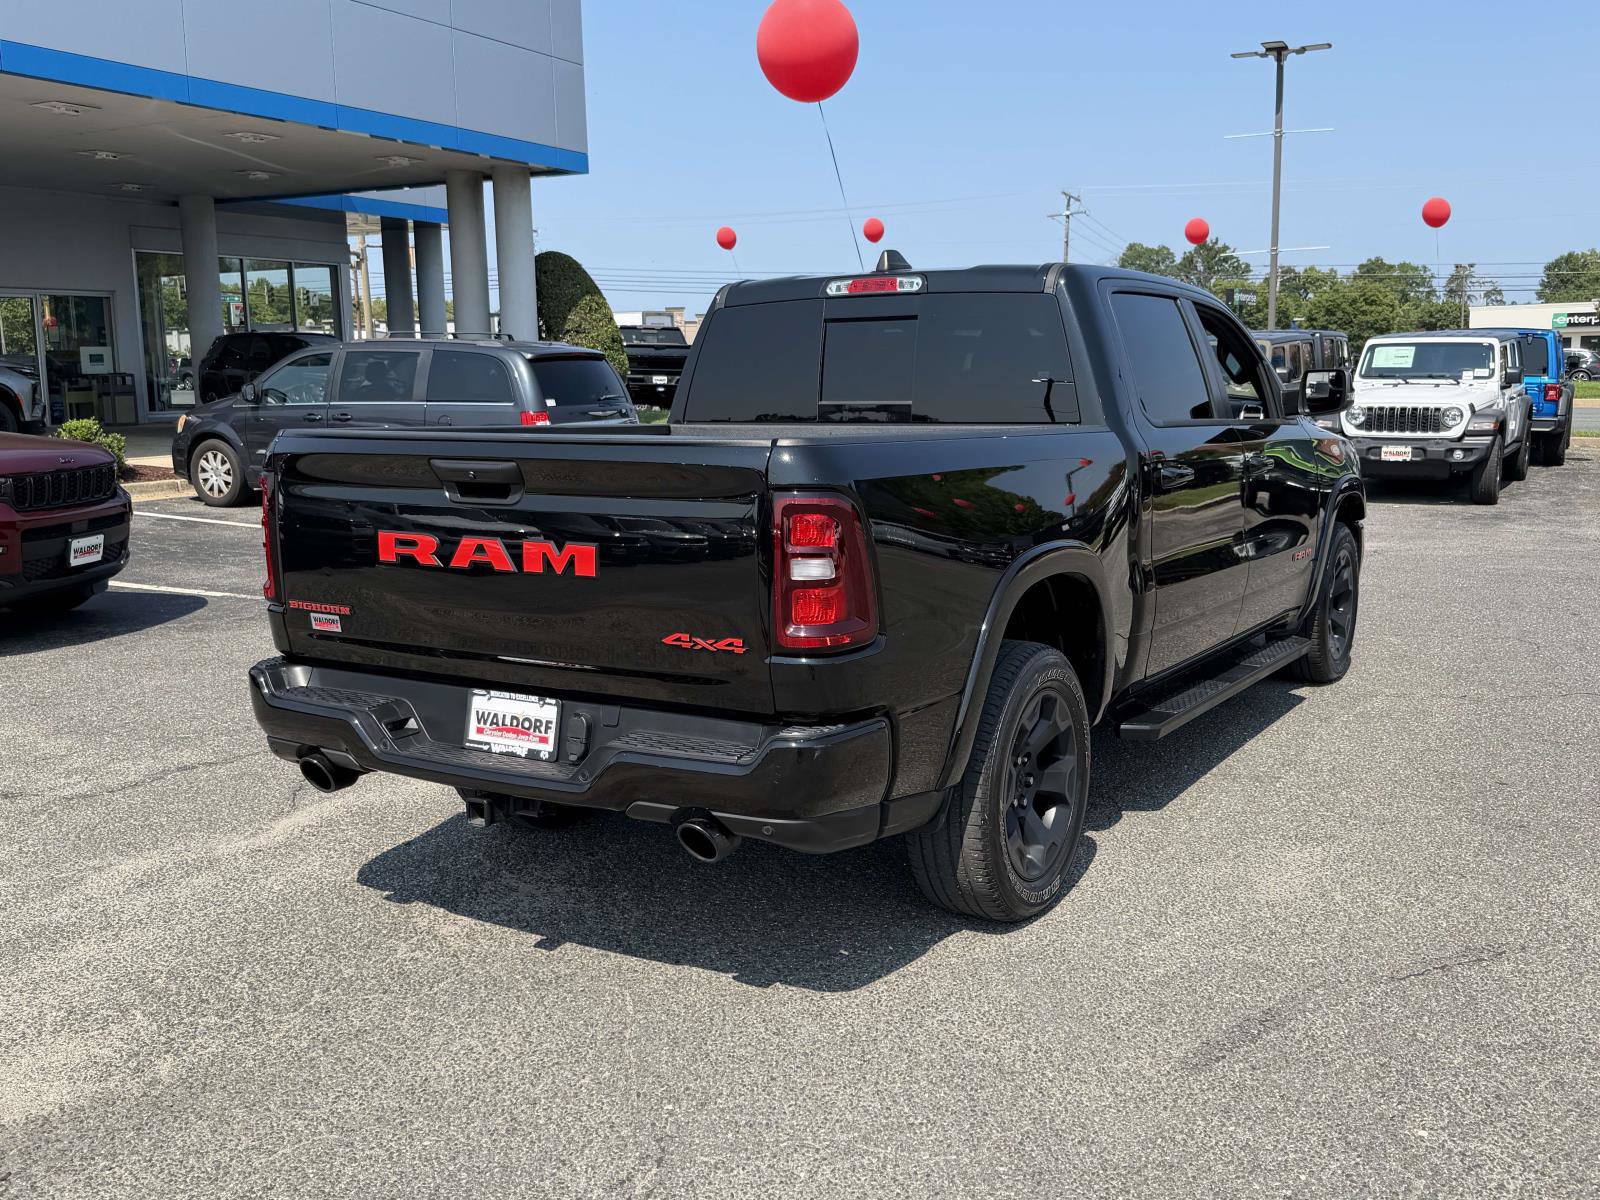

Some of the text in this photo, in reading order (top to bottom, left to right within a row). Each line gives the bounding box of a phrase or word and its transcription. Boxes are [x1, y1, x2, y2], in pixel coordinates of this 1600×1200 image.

[73, 543, 102, 555] WALDORF
[377, 529, 598, 577] RAM
[475, 710, 554, 735] WALDORF
